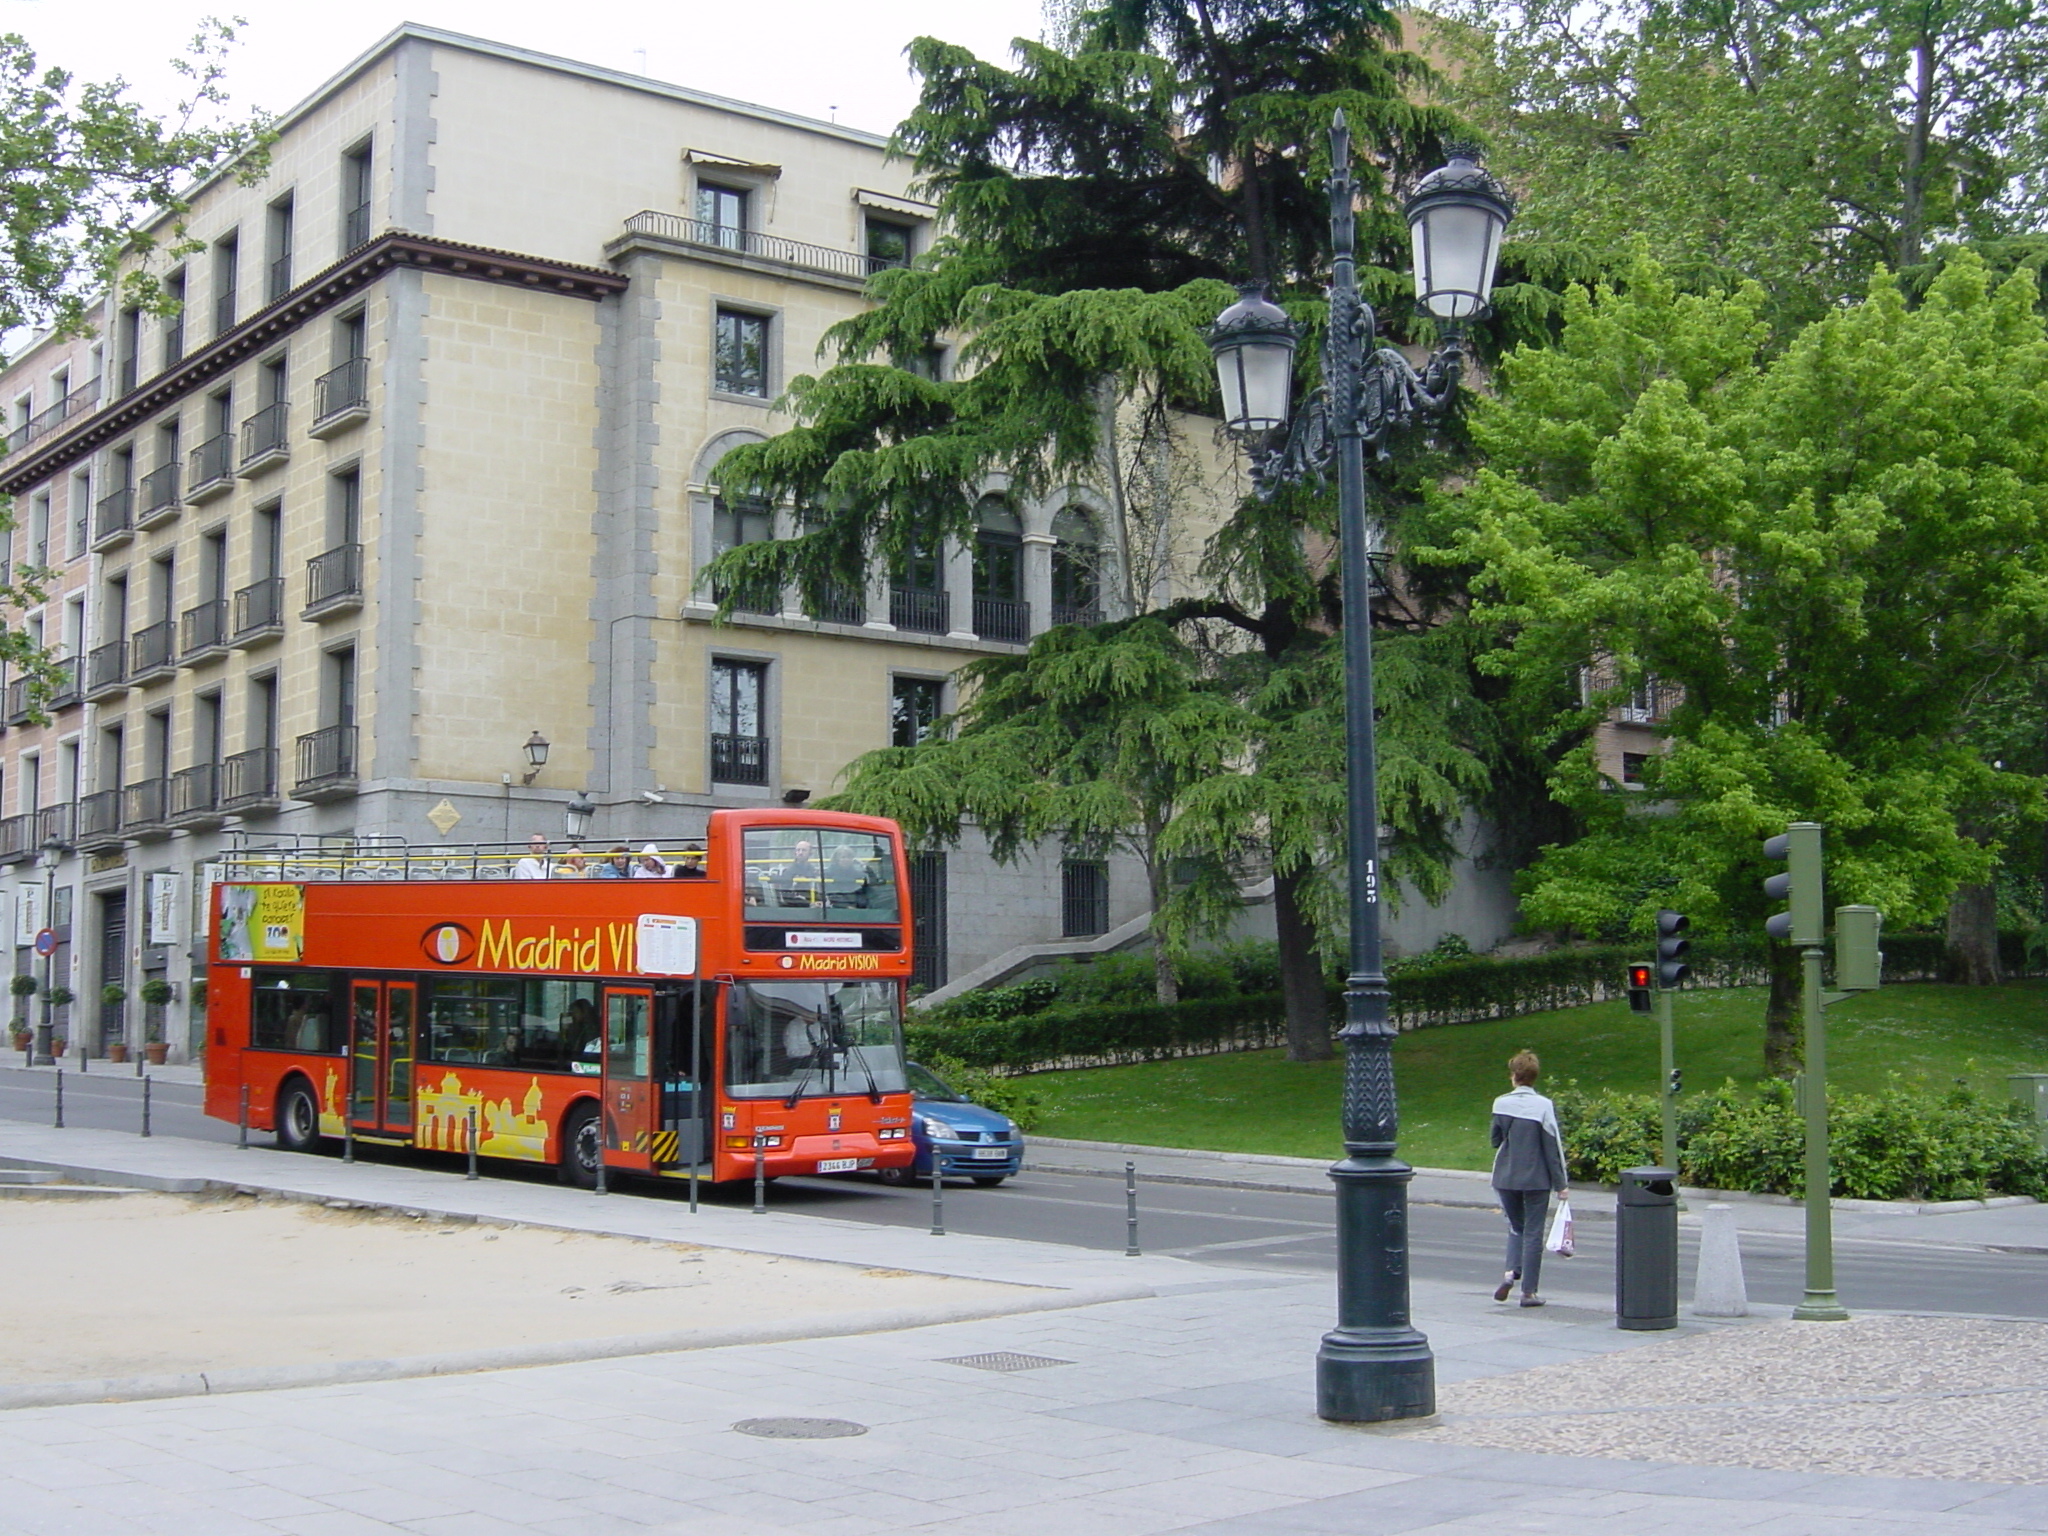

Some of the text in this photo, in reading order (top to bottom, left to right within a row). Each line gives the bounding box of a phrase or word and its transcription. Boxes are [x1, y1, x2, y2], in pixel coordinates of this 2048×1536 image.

[1366, 859, 1377, 904] 195
[477, 918, 600, 973] Madrid
[800, 953, 879, 971] Madrid VISION
